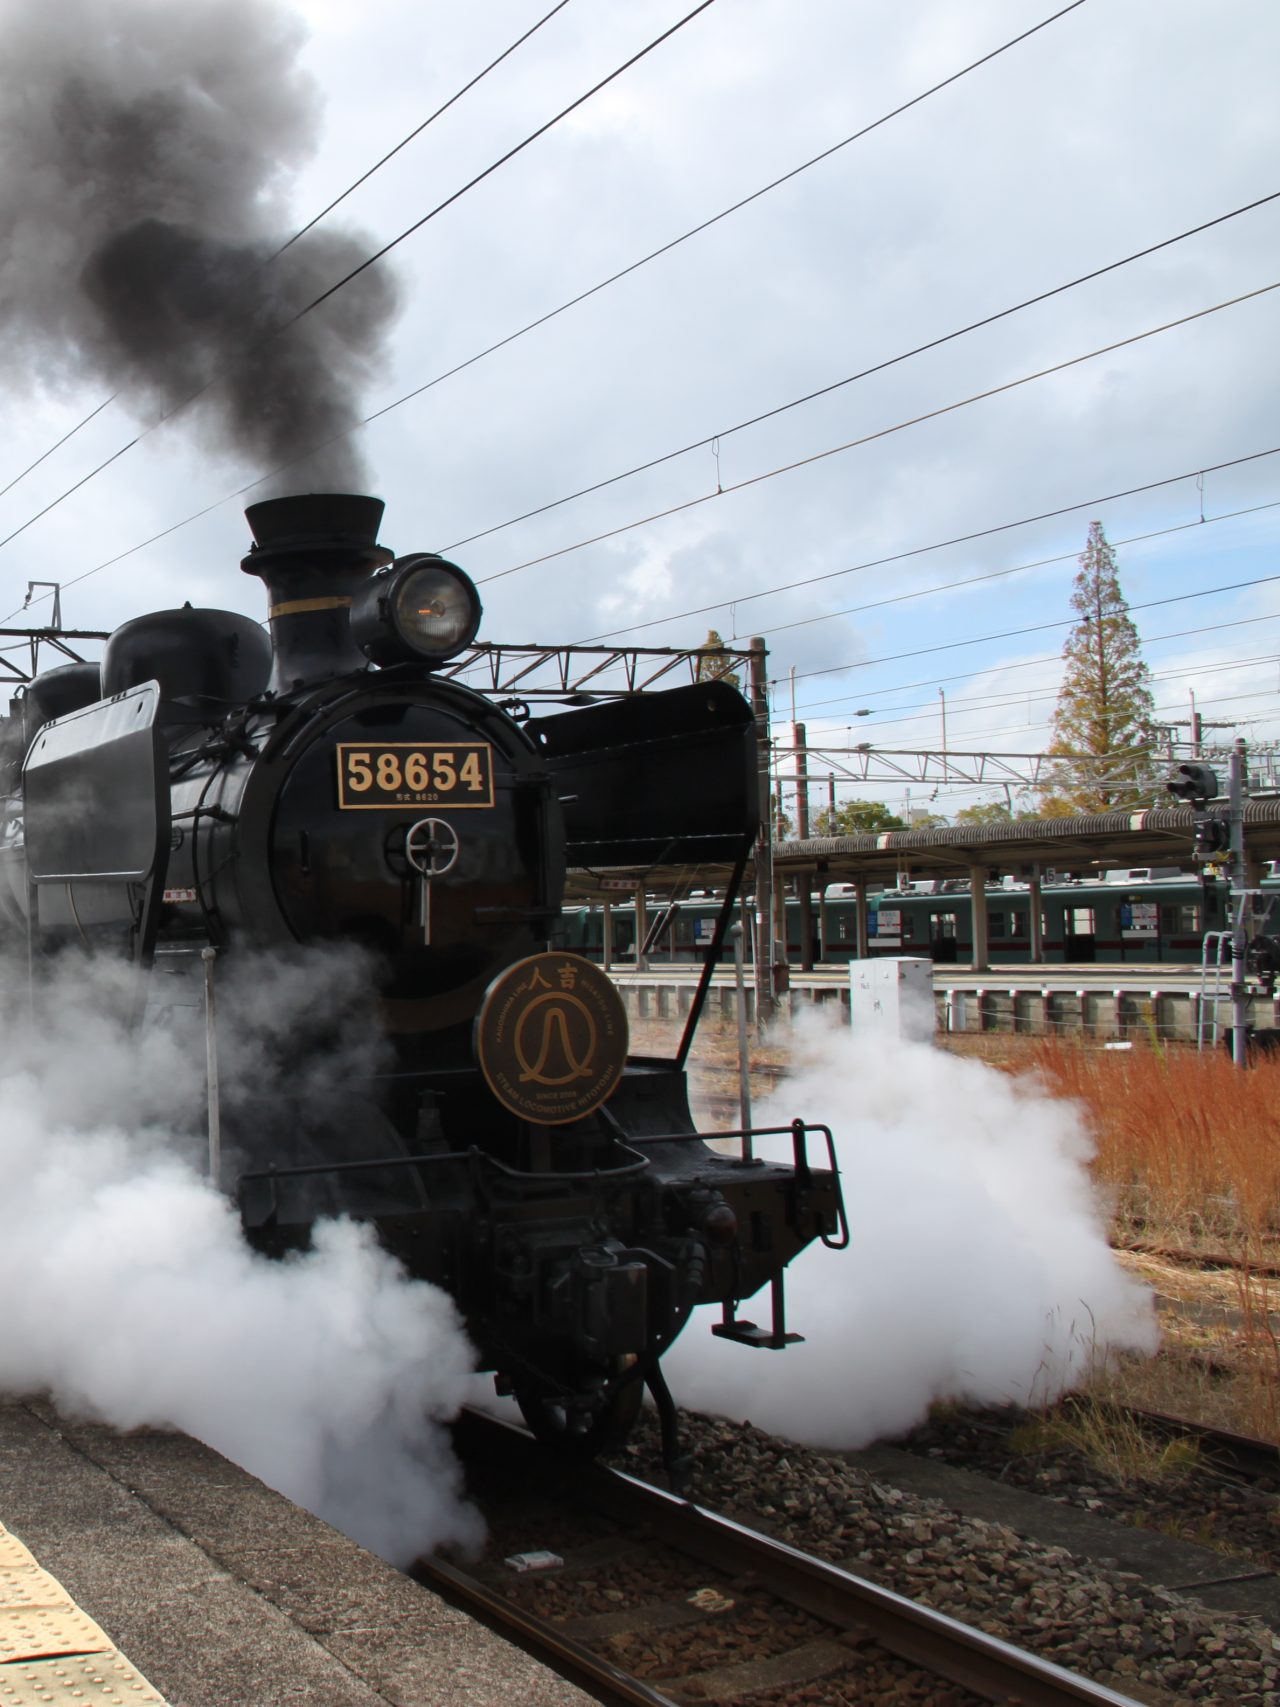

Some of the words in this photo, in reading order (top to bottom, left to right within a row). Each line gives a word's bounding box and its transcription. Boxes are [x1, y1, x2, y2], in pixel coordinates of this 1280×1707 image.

[348, 752, 483, 791] 58654
[1047, 869, 1055, 882] 5
[528, 962, 578, 989] 人吉
[496, 995, 514, 1043] KAGOSHIMA
[496, 1072, 520, 1101] STEAM
[519, 1098, 577, 1114] LOCOMOTIVE
[579, 1064, 615, 1106] HITOYOSHI
